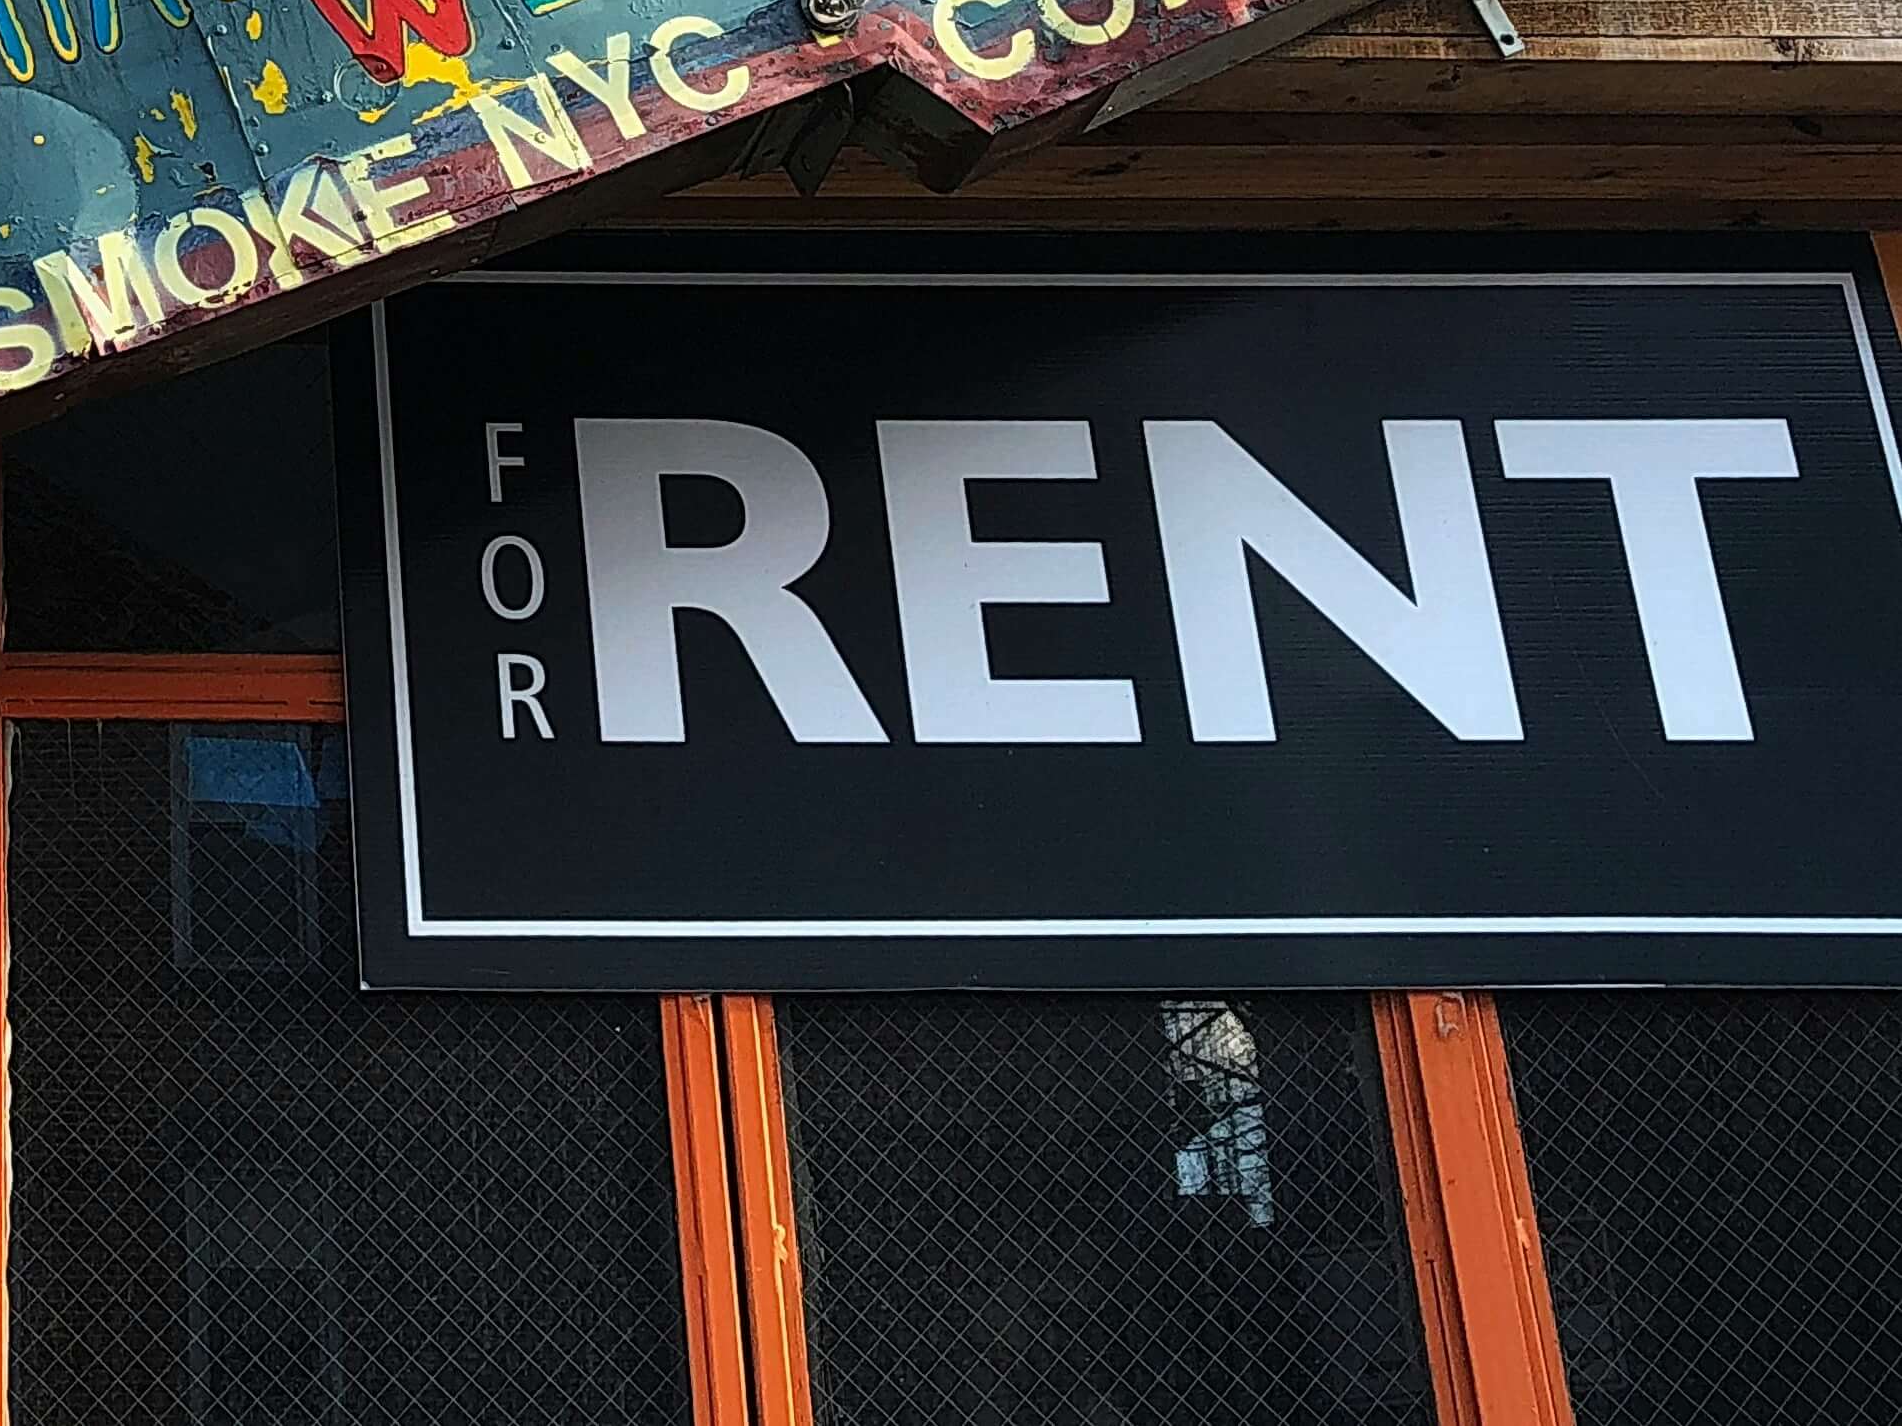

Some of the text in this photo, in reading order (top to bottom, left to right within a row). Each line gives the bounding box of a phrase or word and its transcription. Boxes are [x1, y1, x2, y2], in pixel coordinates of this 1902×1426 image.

[469, 15, 751, 190] NYC
[481, 416, 1802, 743] FOR RENT
